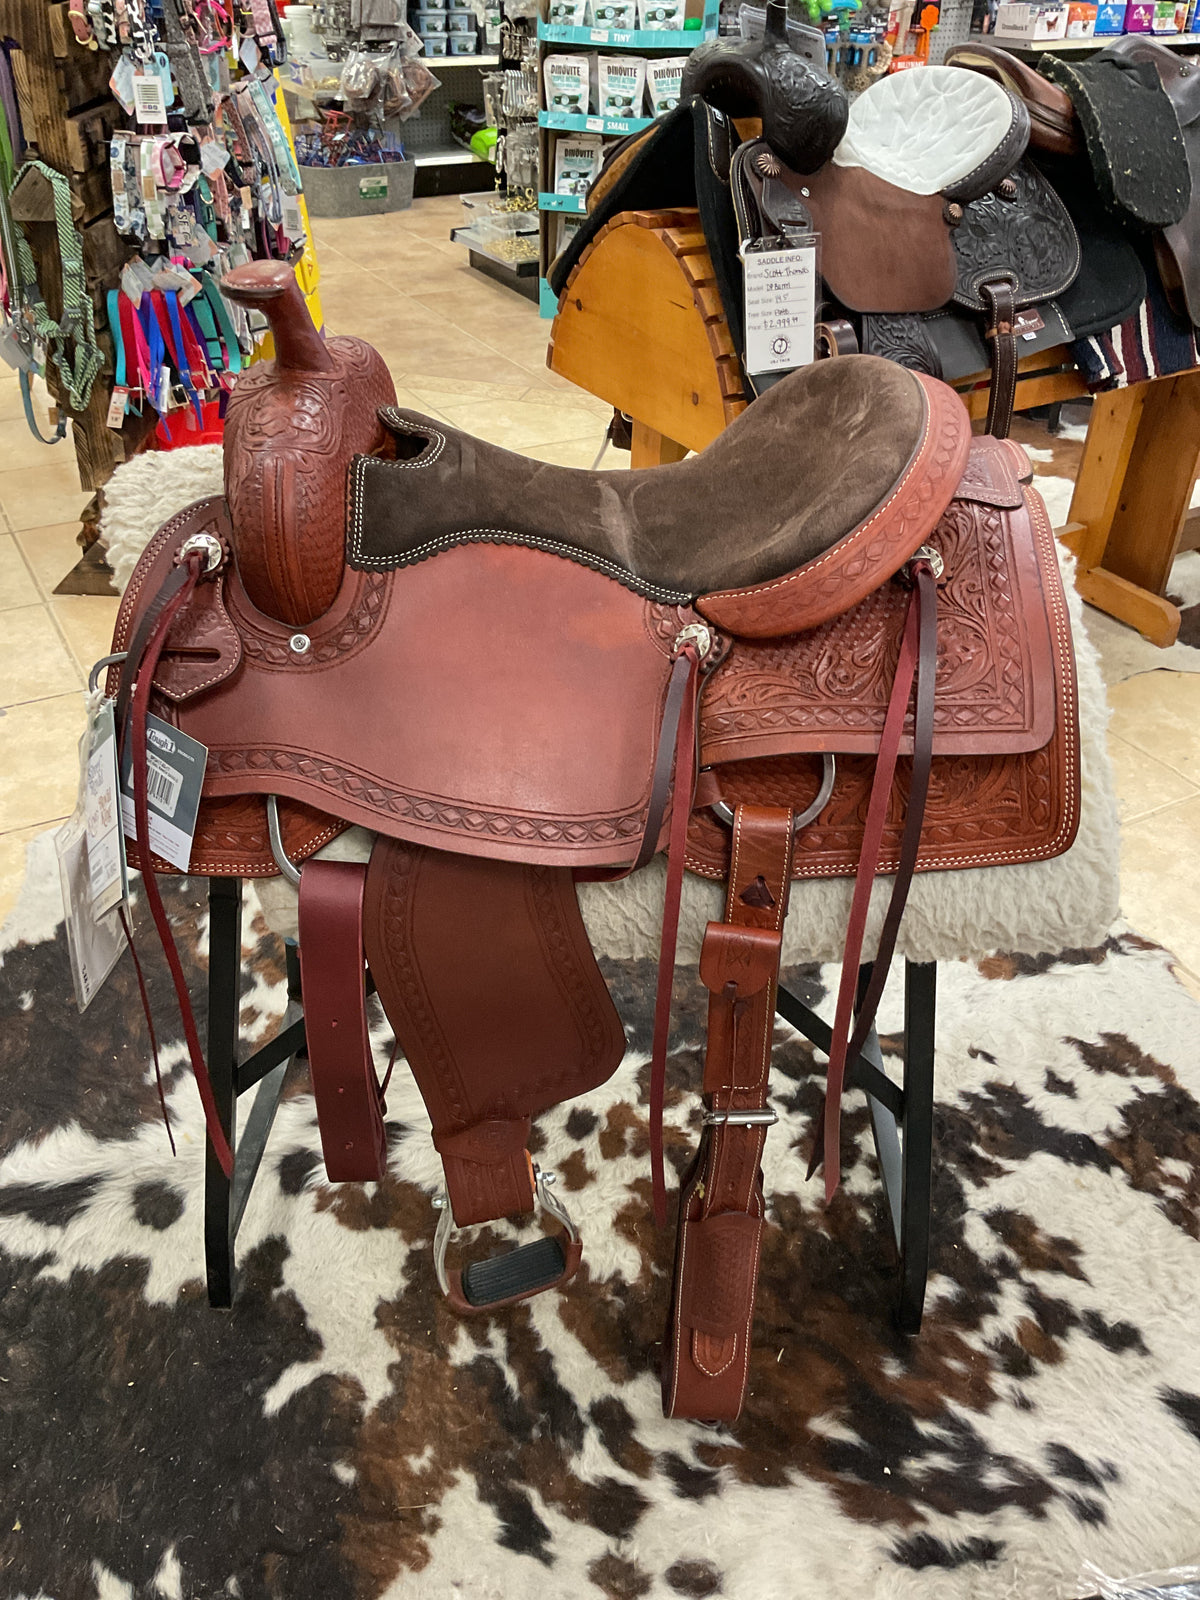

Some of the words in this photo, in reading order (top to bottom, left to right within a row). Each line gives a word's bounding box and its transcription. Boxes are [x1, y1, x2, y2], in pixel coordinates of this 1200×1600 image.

[613, 33, 631, 42] TINY
[607, 121, 629, 131] SMALL
[757, 256, 784, 266] SADDLE
